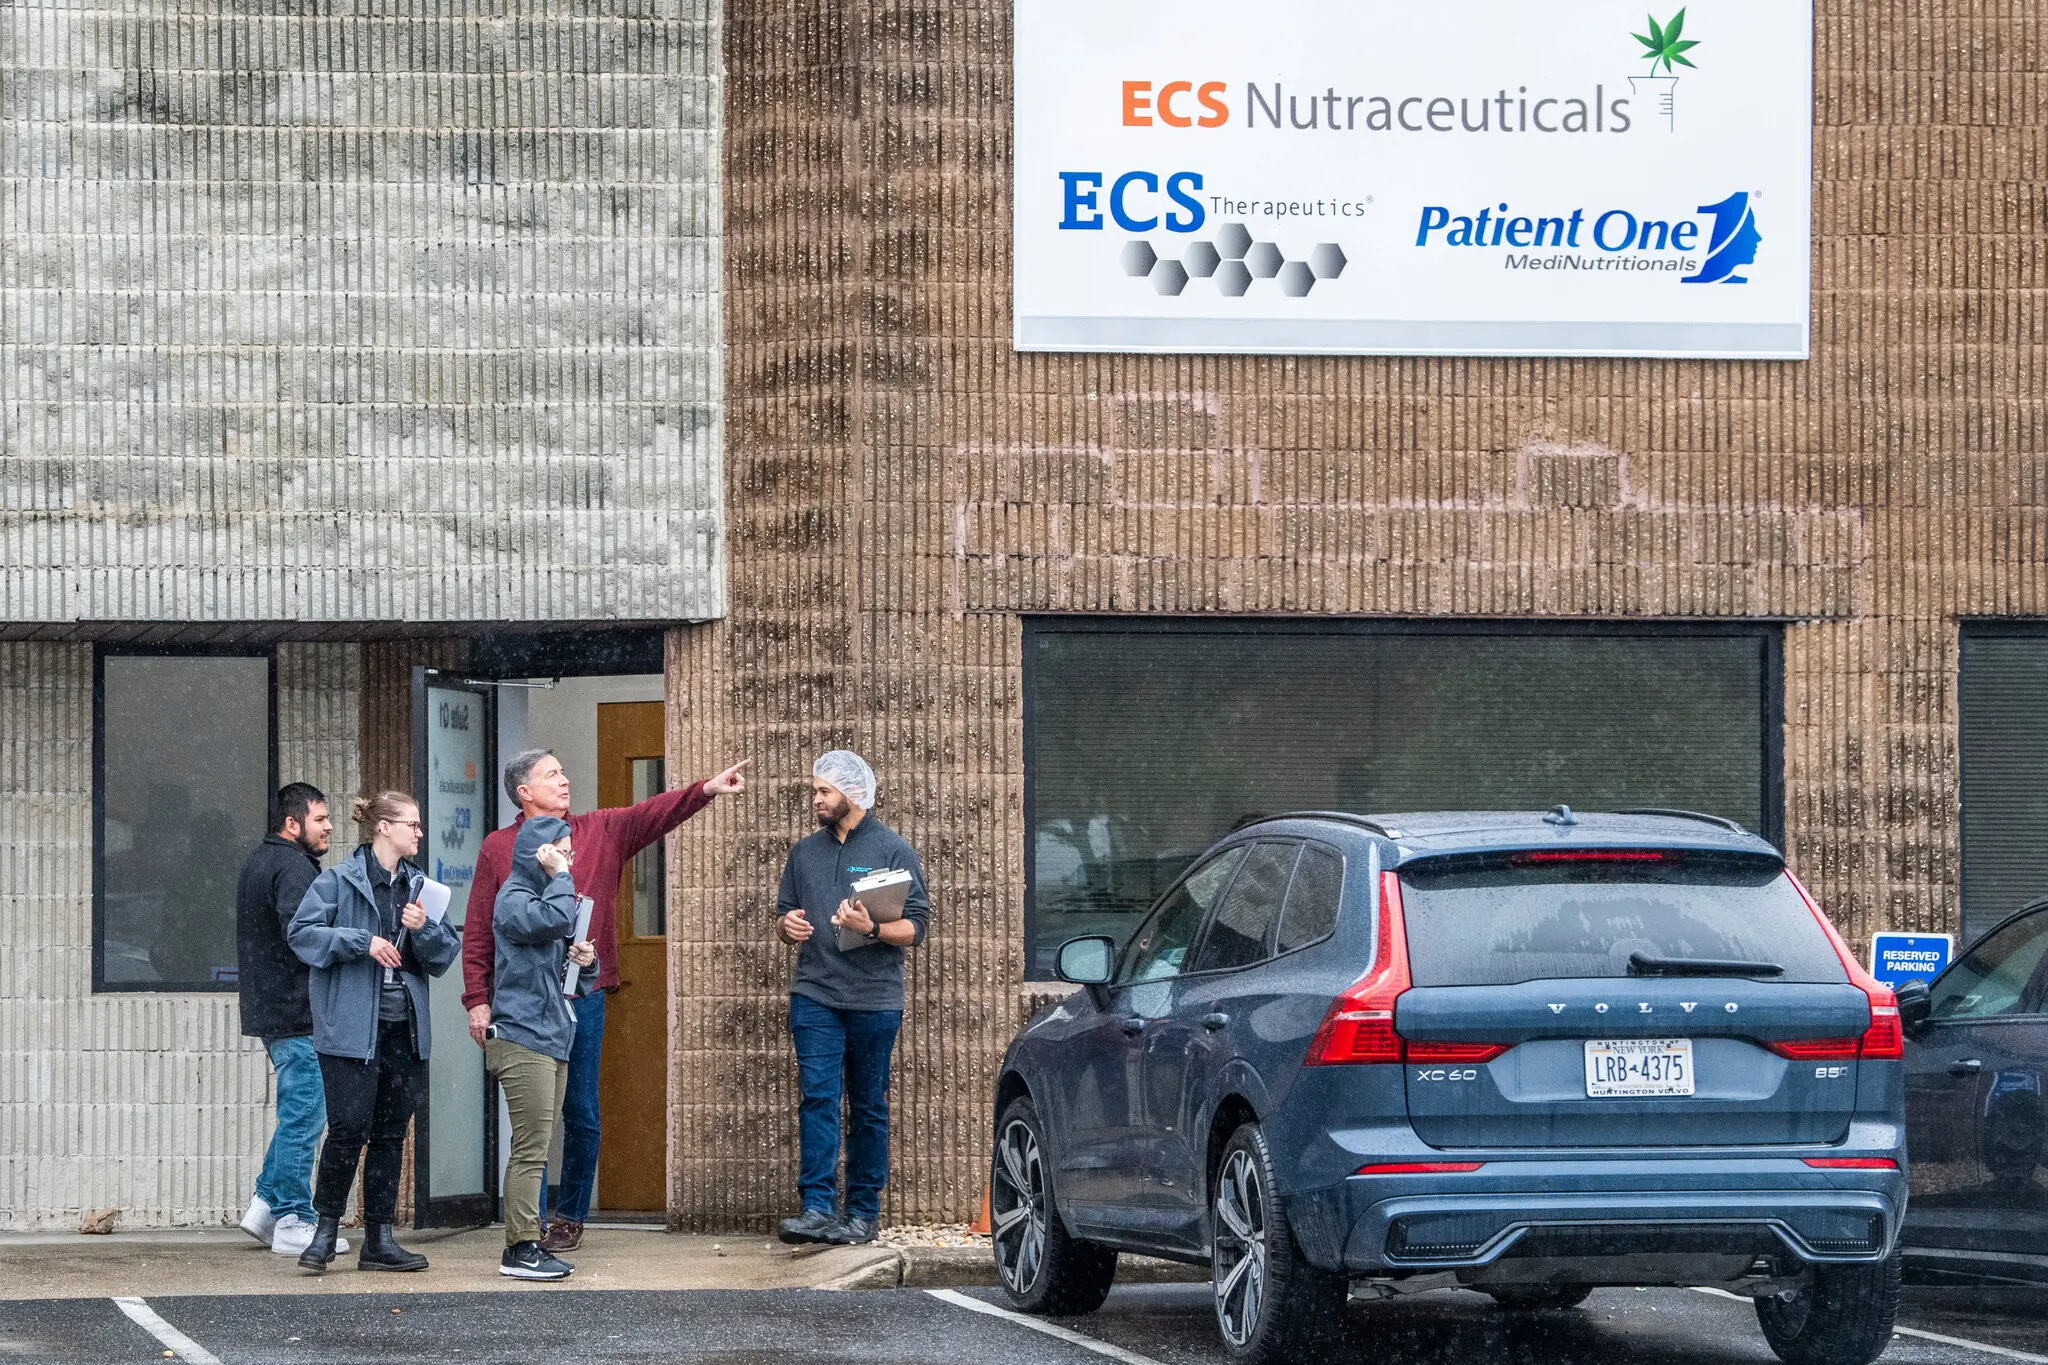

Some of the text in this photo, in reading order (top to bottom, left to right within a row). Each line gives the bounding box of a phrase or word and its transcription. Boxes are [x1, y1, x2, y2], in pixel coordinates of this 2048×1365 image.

[1121, 80, 1632, 134] ECS Nutraceuticals
[1058, 170, 1206, 233] ECS
[1415, 202, 1584, 248] Patient
[1593, 209, 1699, 252] One
[1504, 254, 1697, 272] MediNutritionals
[1883, 950, 1940, 961] RESERVED
[1886, 961, 1935, 972] PARKING
[1548, 1002, 1739, 1014] VOLVO
[1613, 1045, 1665, 1055] NEW YORK
